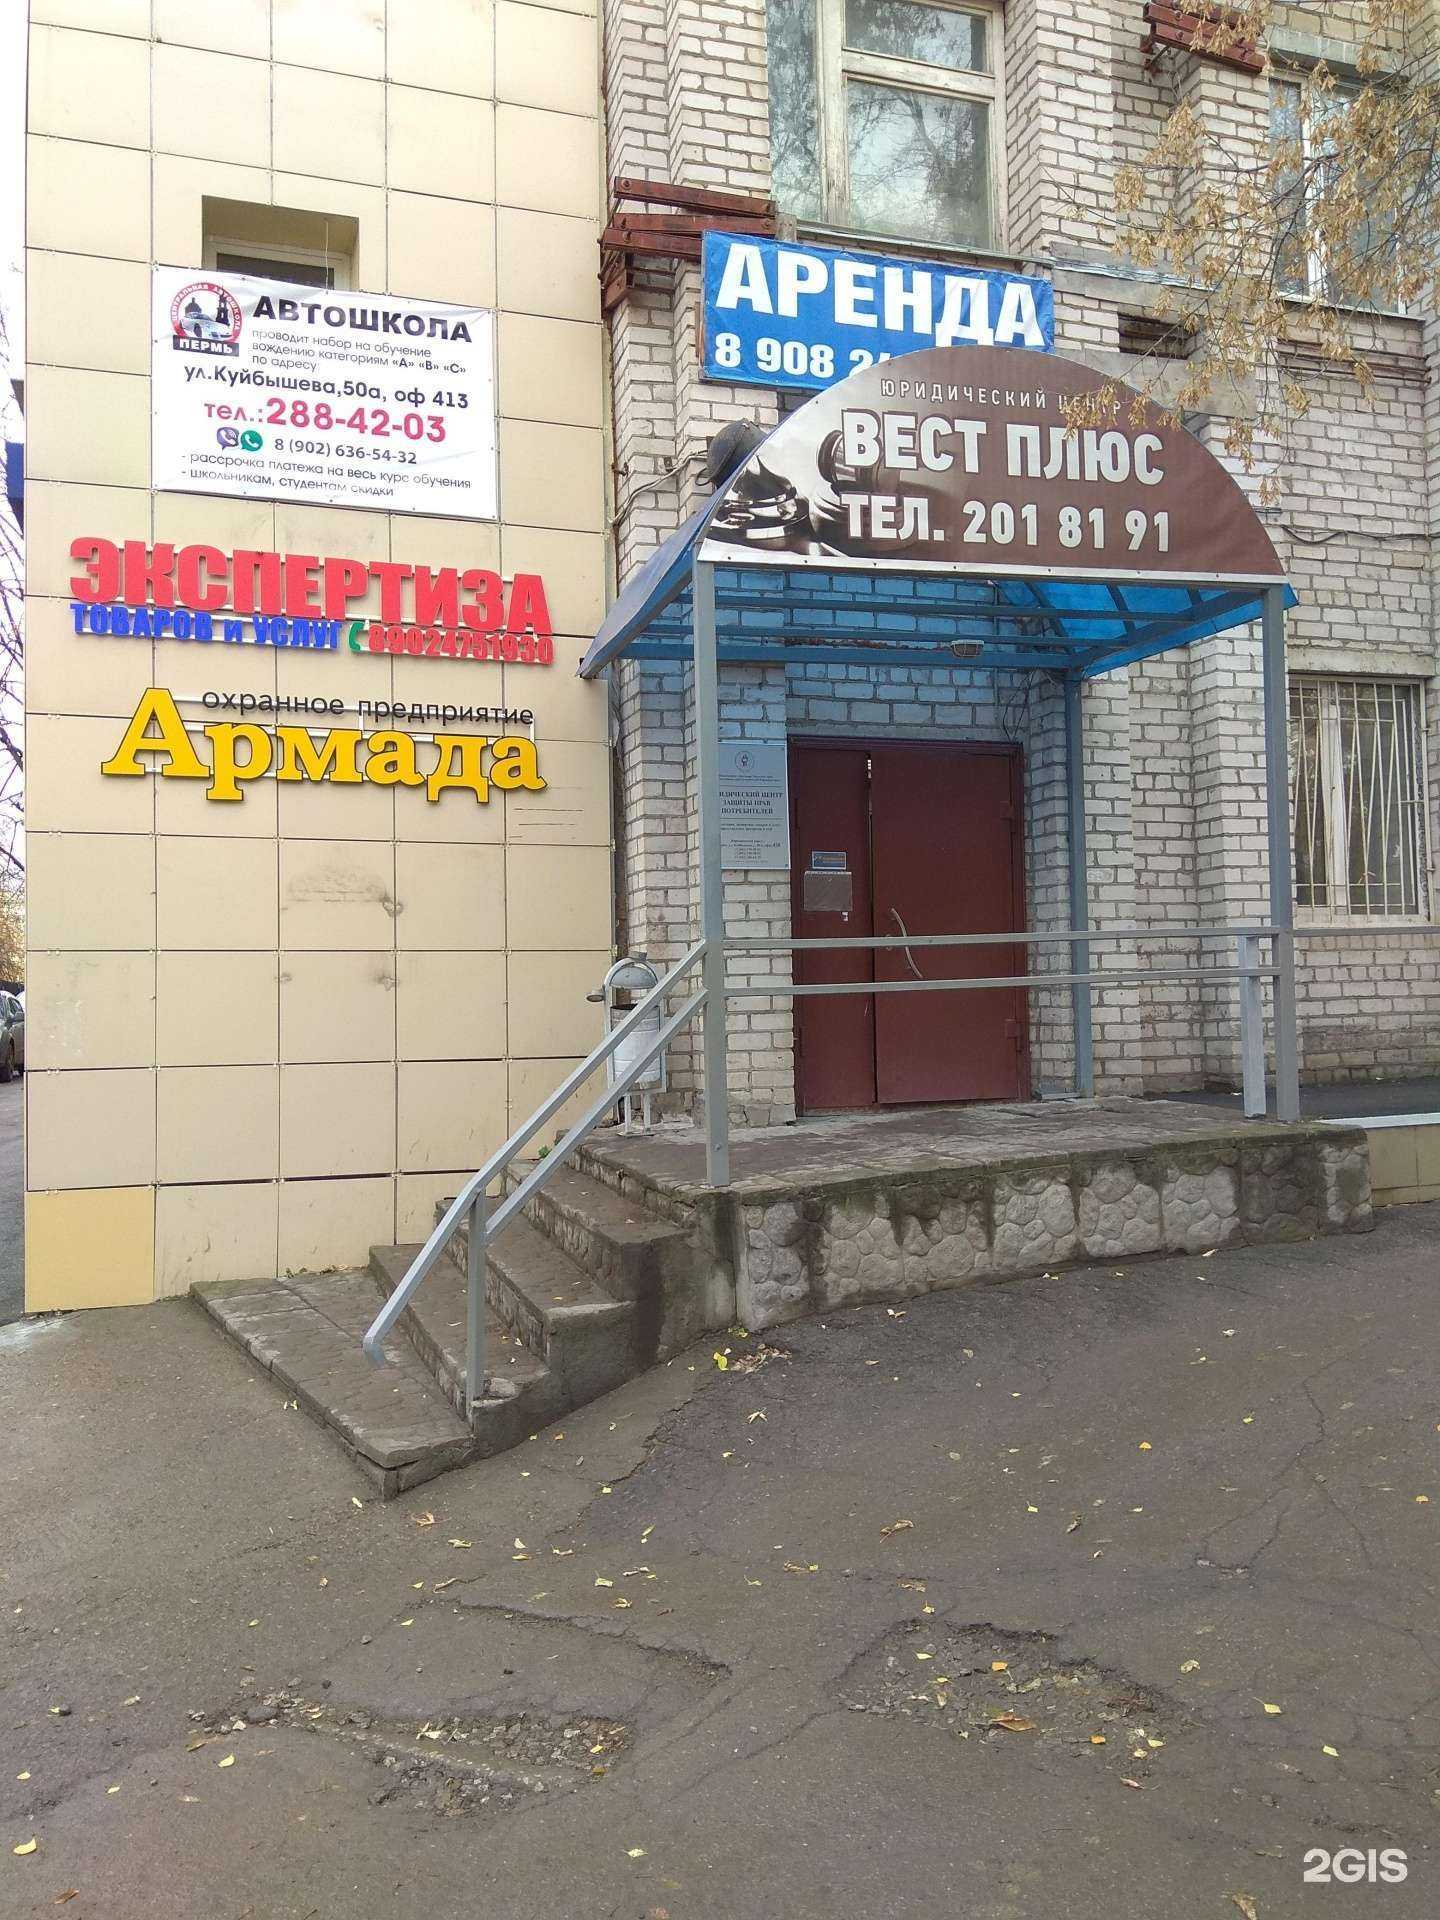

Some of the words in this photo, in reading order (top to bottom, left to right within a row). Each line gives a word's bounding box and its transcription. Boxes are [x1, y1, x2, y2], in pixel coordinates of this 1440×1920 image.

[716, 243, 1045, 347] АРЕНДА
[253, 295, 472, 343] АВТОШКОЛА
[179, 339, 233, 354] ПЕРМЬ
[252, 330, 309, 344] проводит
[313, 337, 351, 350] набор
[355, 341, 371, 351] на
[374, 342, 432, 358] обучение
[252, 342, 315, 358] вождению
[318, 350, 389, 367] категориям
[252, 355, 268, 365] по
[715, 333, 741, 367] 8
[756, 337, 835, 378] 908
[394, 387, 426, 408] оф
[432, 390, 469, 409] 413
[880, 379, 1047, 409] ЮРИДИЧЕСКИЙ
[274, 438, 284, 451] 8
[289, 439, 331, 458] (902)
[335, 444, 417, 465] 636-54-32
[841, 409, 988, 474] ВЕСТ
[1006, 423, 1164, 485] ПЛЮС
[190, 453, 265, 469] рассрочка
[269, 460, 324, 475] платежа
[327, 466, 344, 477] на
[347, 468, 376, 480] весь
[380, 471, 409, 484] курс
[413, 473, 471, 489] обучения
[190, 468, 275, 487] школьникам,
[279, 477, 347, 492] студентам
[350, 485, 394, 497] скидки
[841, 494, 945, 541] ТЕЛ.
[962, 500, 1038, 546] 201
[1058, 506, 1105, 549] 81
[1125, 510, 1169, 552] 91
[70, 537, 553, 635] ЭКСПЕРТИЗА
[70, 603, 213, 642] ТОВАРОВ
[252, 614, 343, 650] УСЛУГ
[368, 624, 554, 665] 89024751930
[202, 691, 344, 716] охранное
[358, 699, 534, 726] предприятие
[101, 687, 547, 803] Армада
